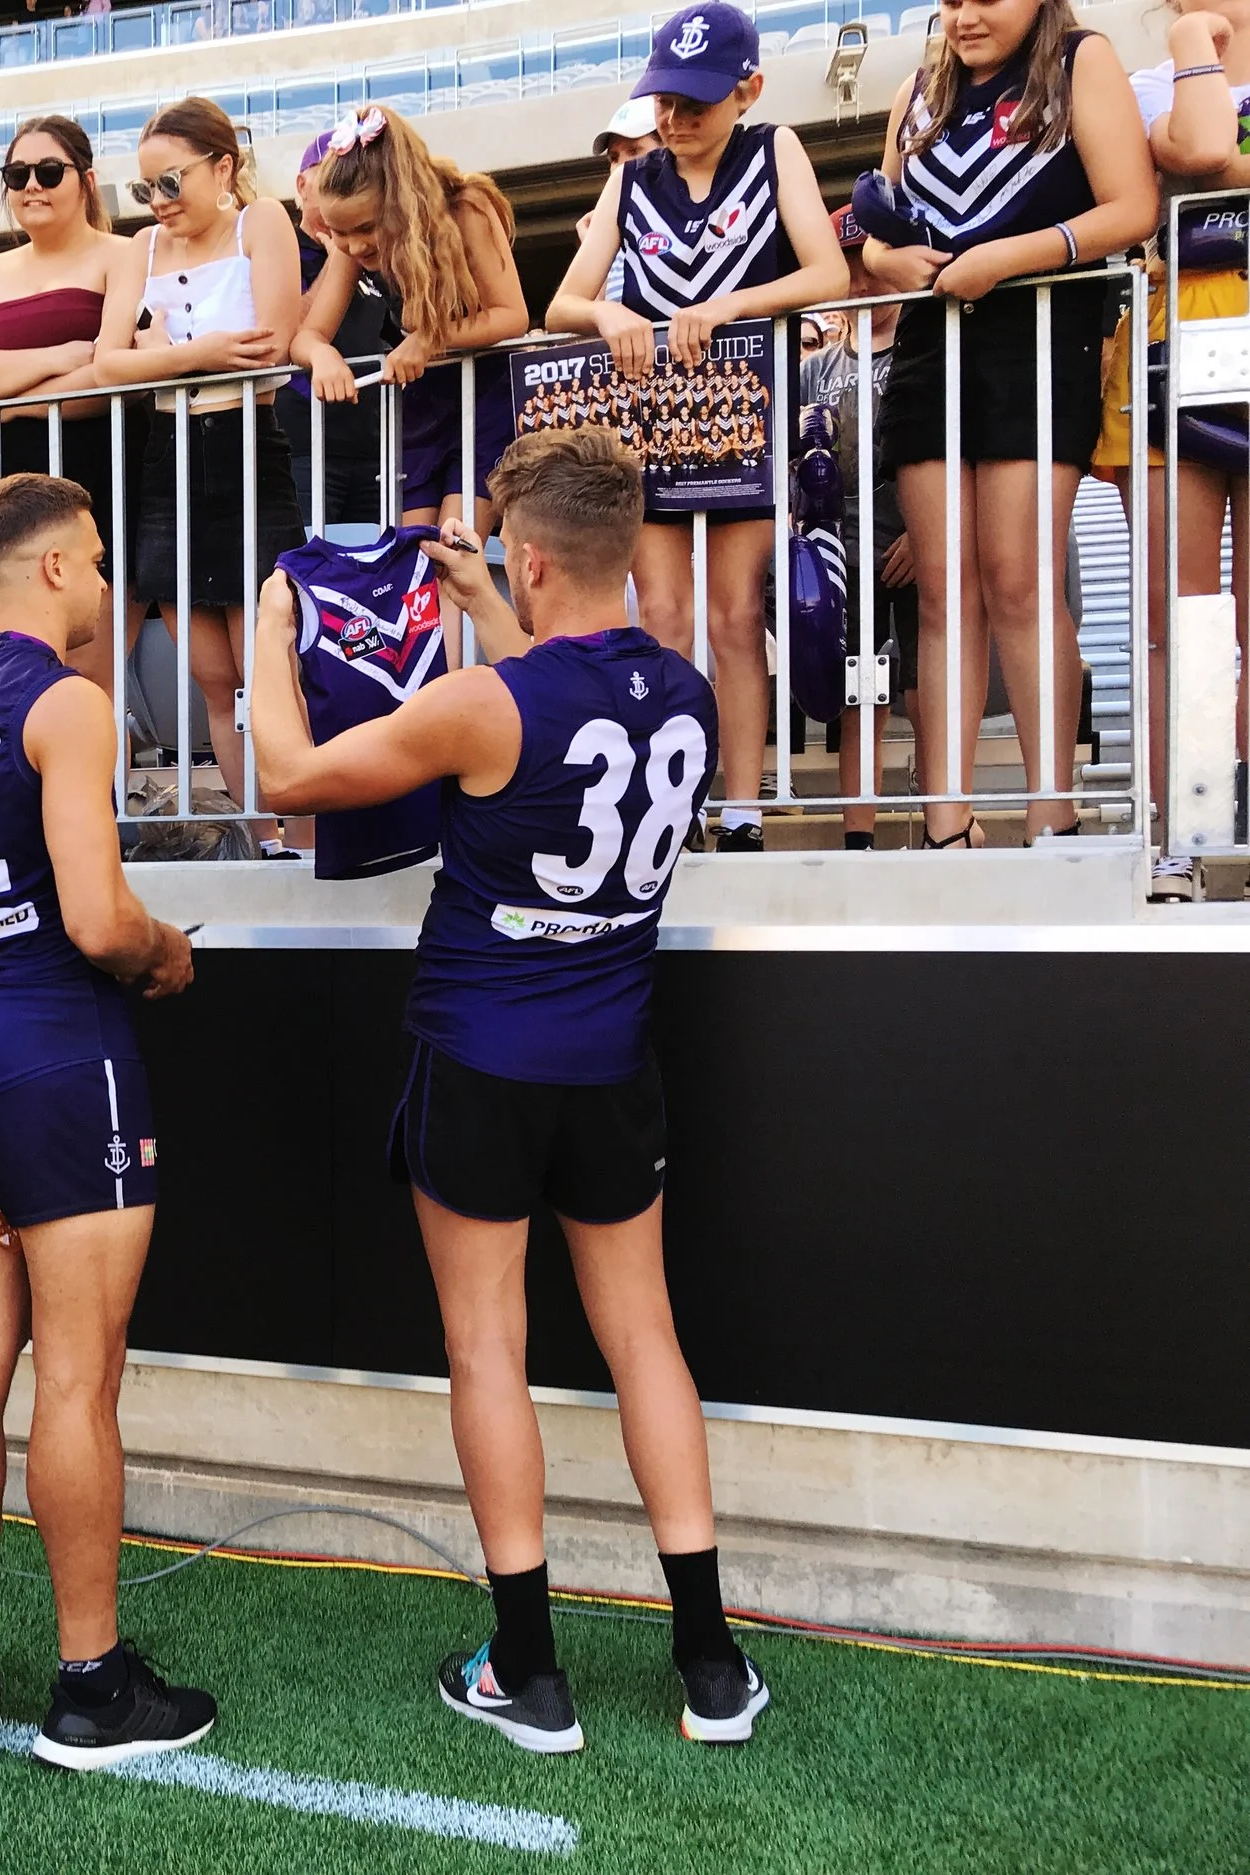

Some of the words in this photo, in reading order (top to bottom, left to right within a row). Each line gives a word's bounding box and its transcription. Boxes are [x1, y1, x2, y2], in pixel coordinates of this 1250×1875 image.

[639, 236, 669, 250] AFL
[706, 233, 747, 251] woodside
[524, 356, 586, 387] 2017
[344, 619, 371, 638] AFL
[352, 642, 366, 654] nab
[532, 714, 707, 903] 38
[558, 886, 582, 895] AFL
[640, 882, 657, 892] AFL
